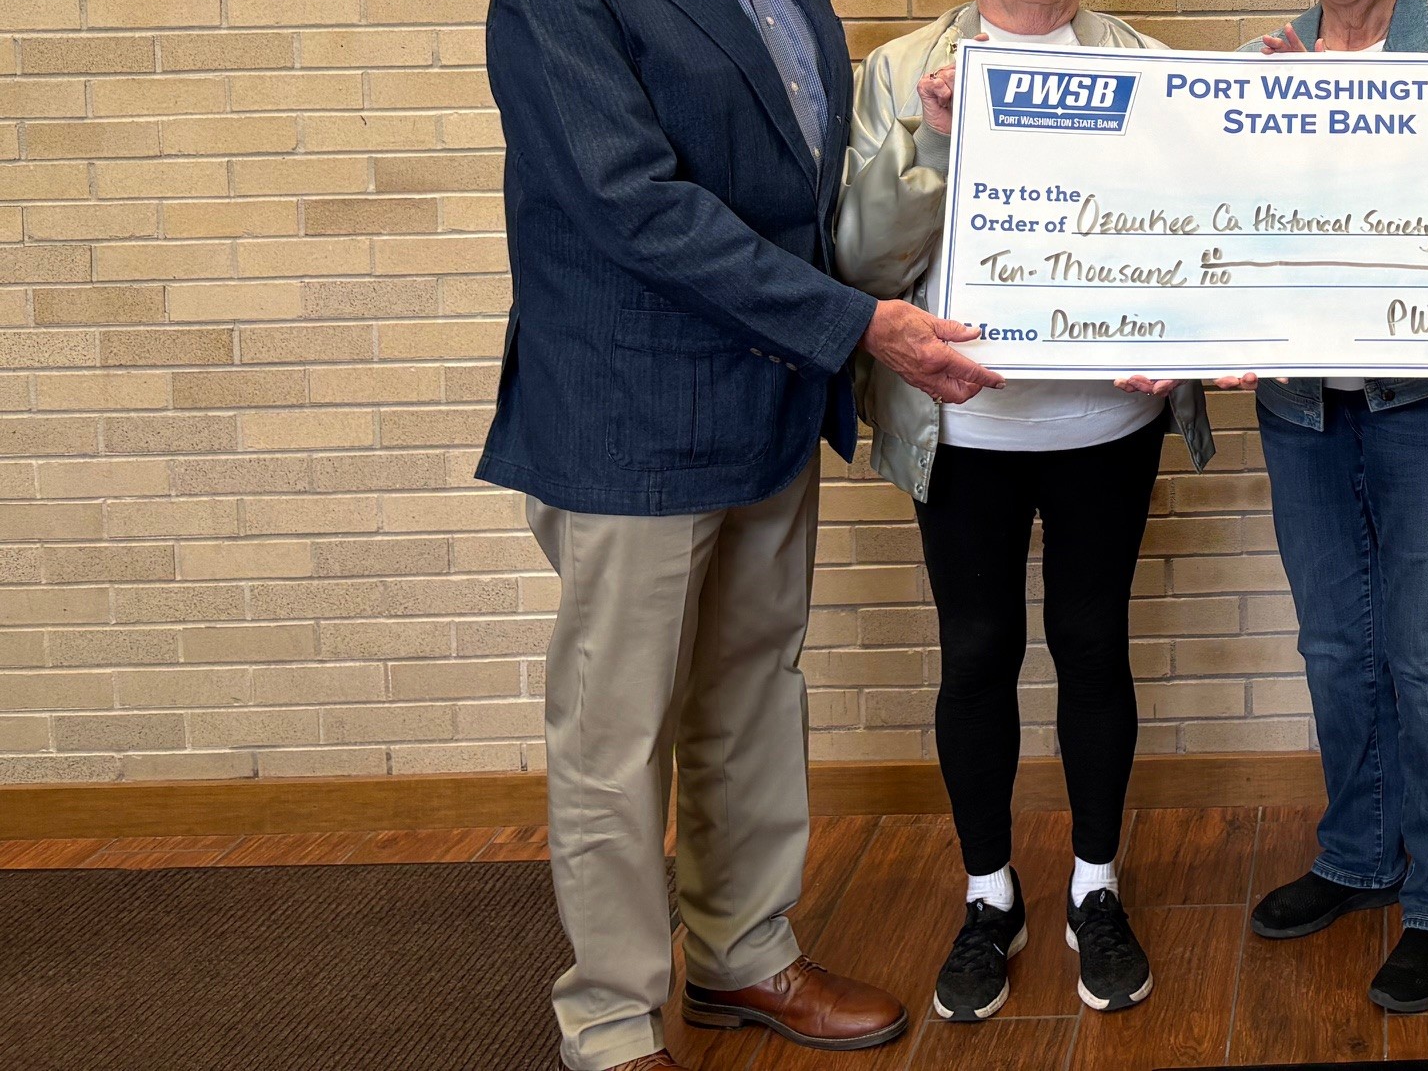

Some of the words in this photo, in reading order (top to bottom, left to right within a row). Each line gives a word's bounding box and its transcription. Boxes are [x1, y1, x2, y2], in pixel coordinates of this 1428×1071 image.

[1004, 73, 1117, 108] PWSB
[1166, 74, 1250, 99] PORT
[998, 115, 1019, 125] PORT
[1020, 116, 1071, 127] WASHINGTON
[1074, 118, 1095, 128] STATE
[1097, 119, 1119, 129] BANK
[1223, 109, 1317, 134] STATE
[1329, 110, 1417, 135] BANK
[973, 183, 1015, 204] Pay
[1019, 185, 1040, 201] to
[1046, 186, 1081, 202] the
[970, 214, 1039, 232] Order
[1044, 215, 1067, 233] of
[1253, 203, 1352, 233] Historical
[1050, 309, 1166, 339] Donation
